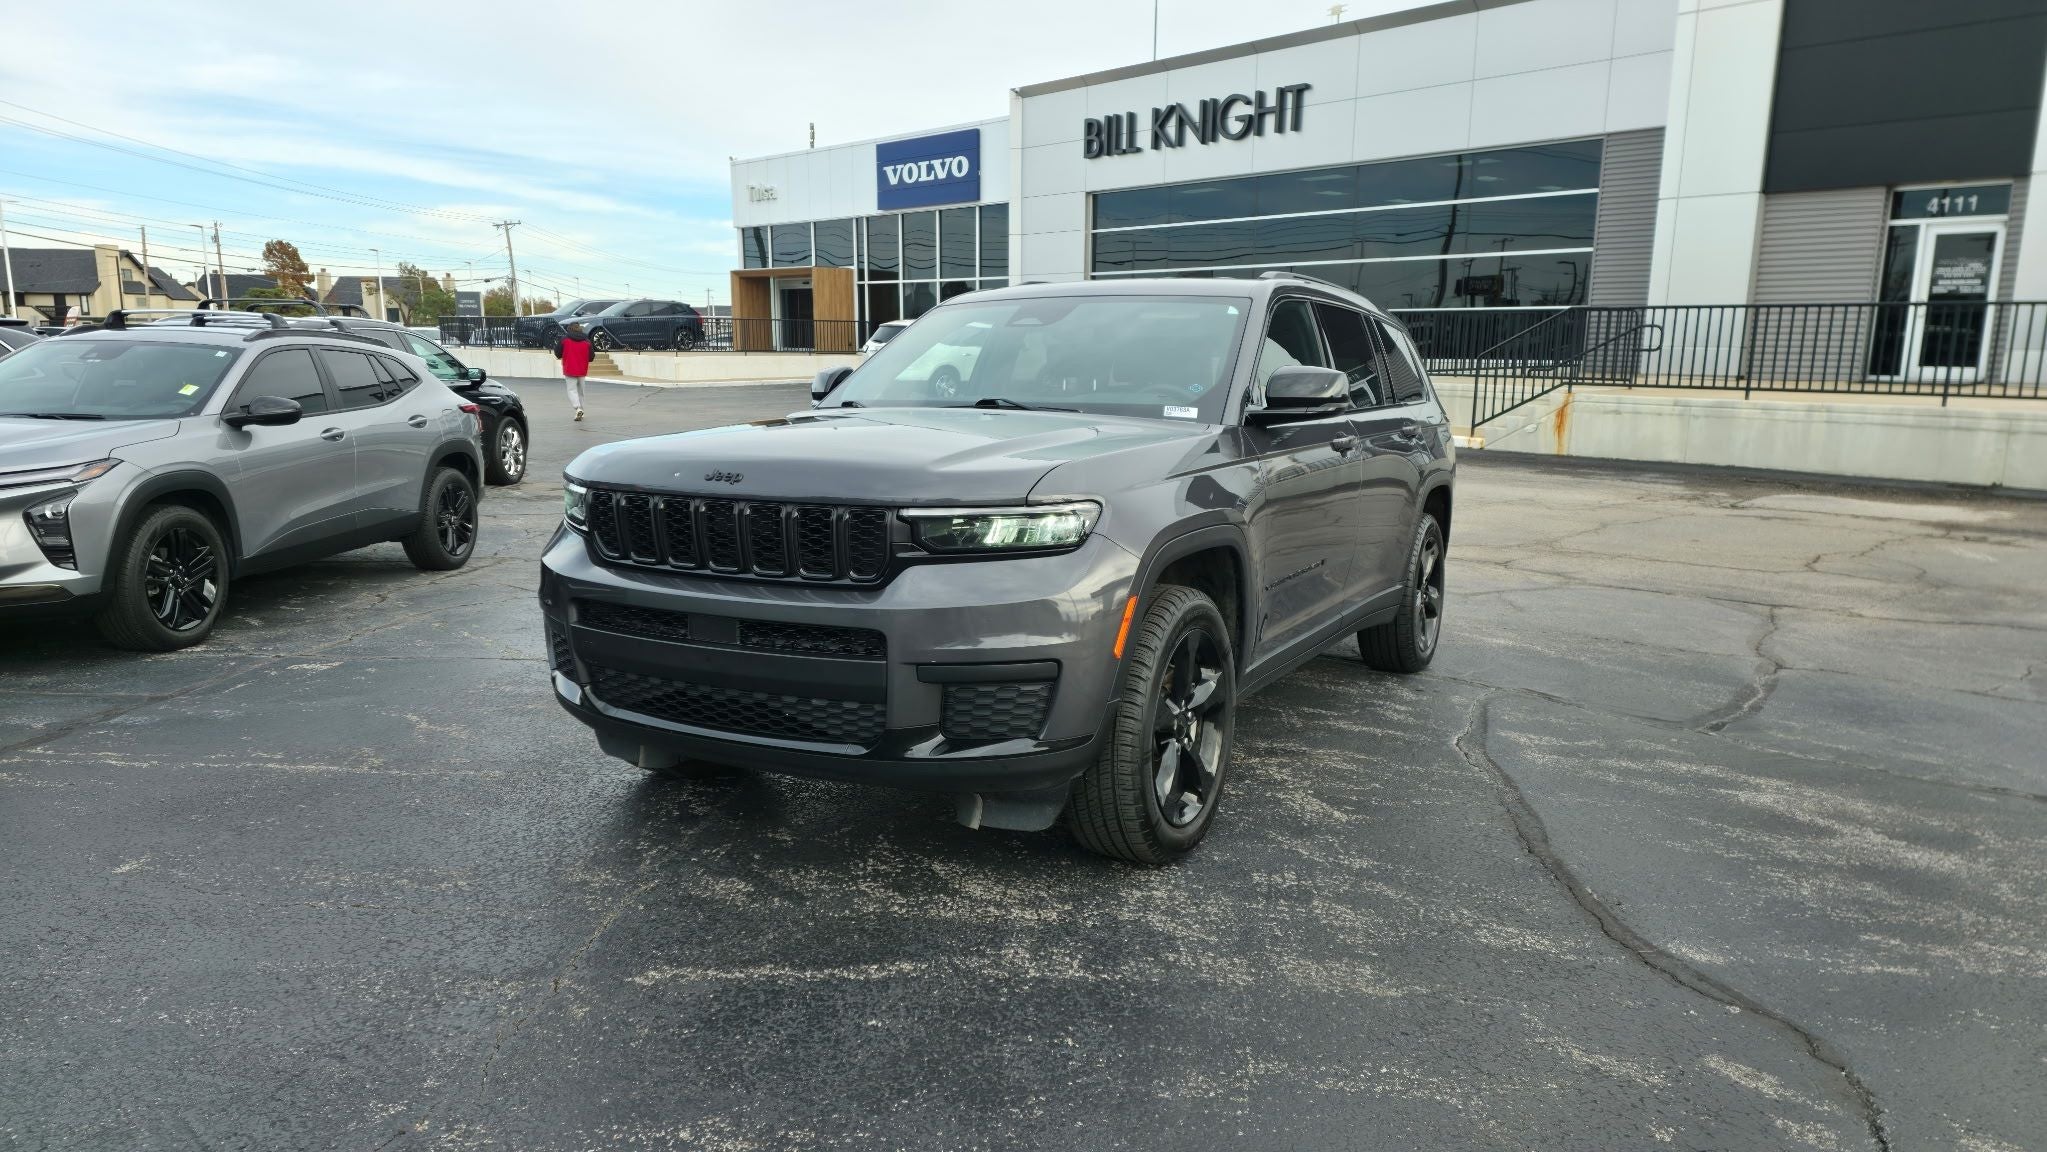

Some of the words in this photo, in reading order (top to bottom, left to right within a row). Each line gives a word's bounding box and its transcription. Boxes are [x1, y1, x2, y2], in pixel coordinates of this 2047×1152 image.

[1084, 112, 1143, 159] BILL
[1151, 83, 1313, 150] KNIGHT
[883, 155, 969, 185] VOLVO
[1927, 195, 1978, 214] 4111
[704, 469, 744, 485] Jeep
